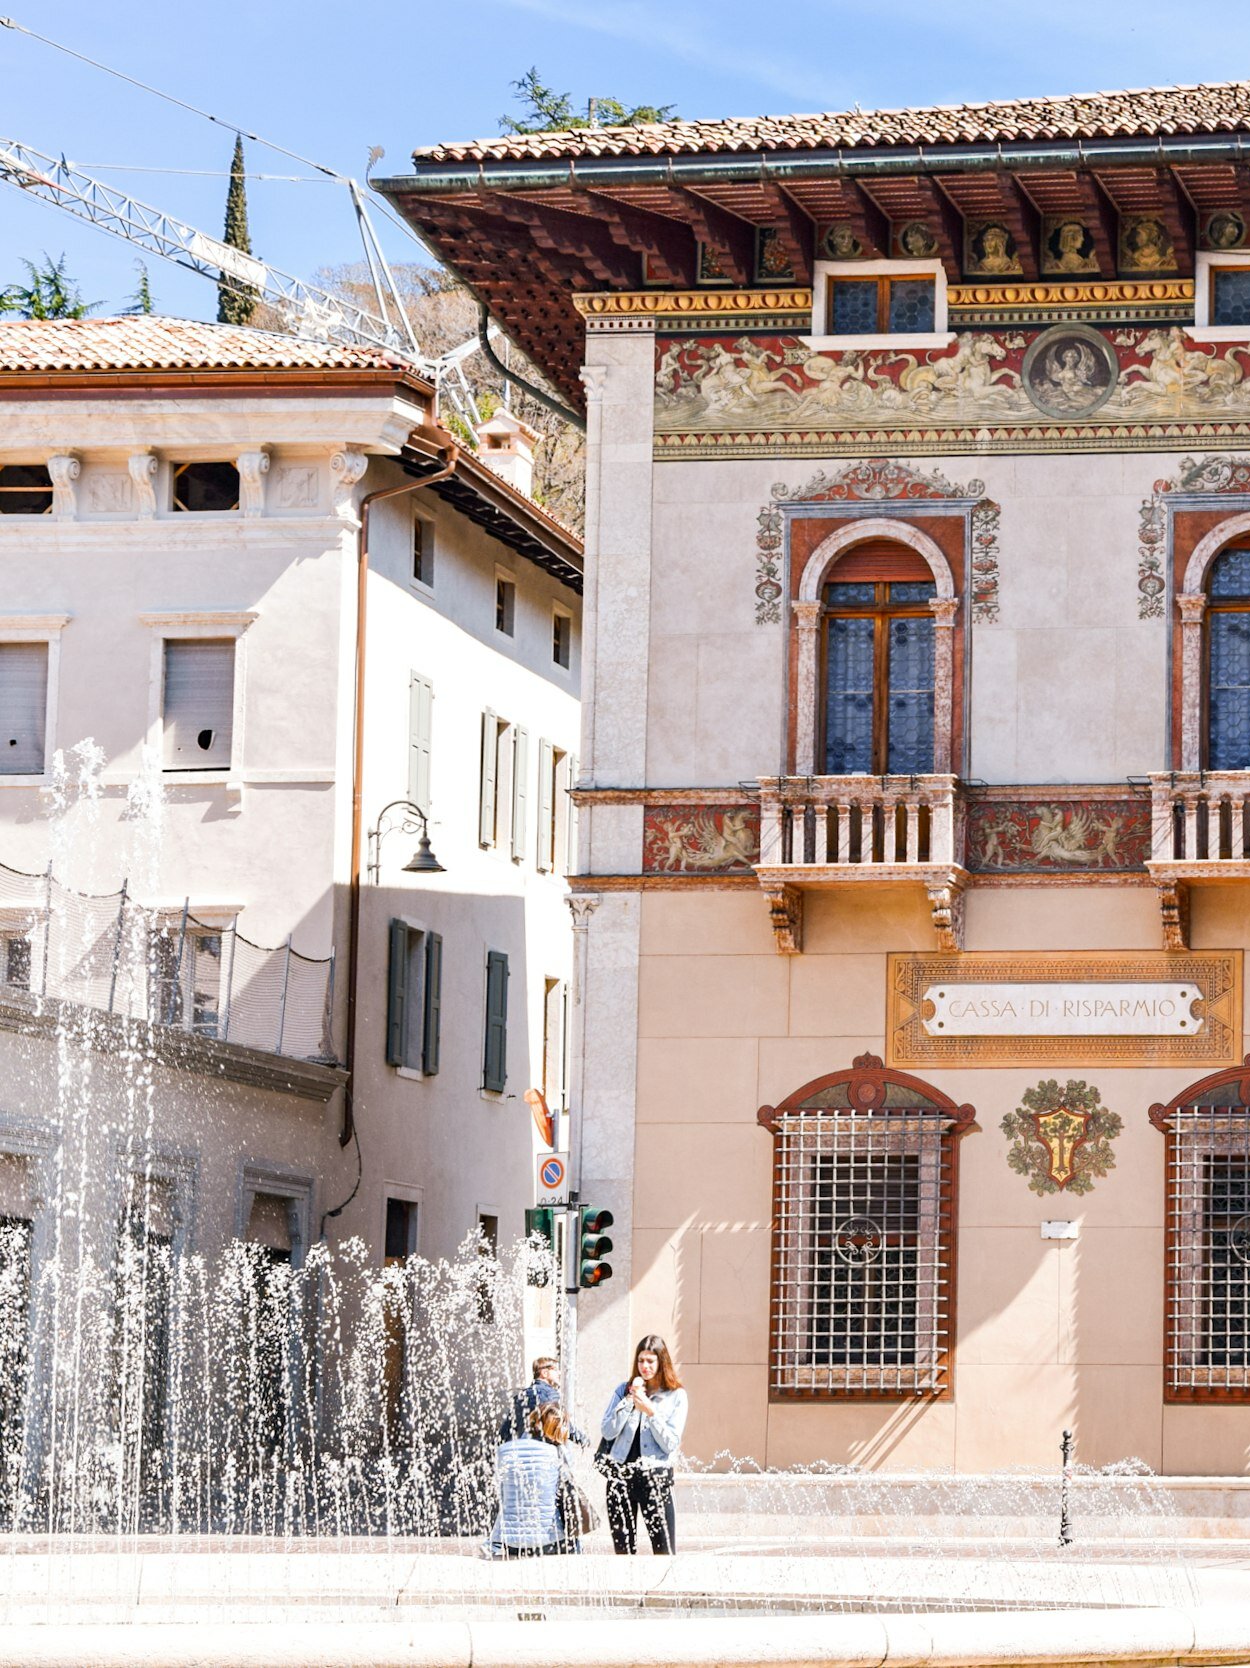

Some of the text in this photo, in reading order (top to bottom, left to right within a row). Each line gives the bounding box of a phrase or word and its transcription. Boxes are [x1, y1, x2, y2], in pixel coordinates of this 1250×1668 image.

[949, 1000, 1176, 1018] CASSA DI RISPARMIO
